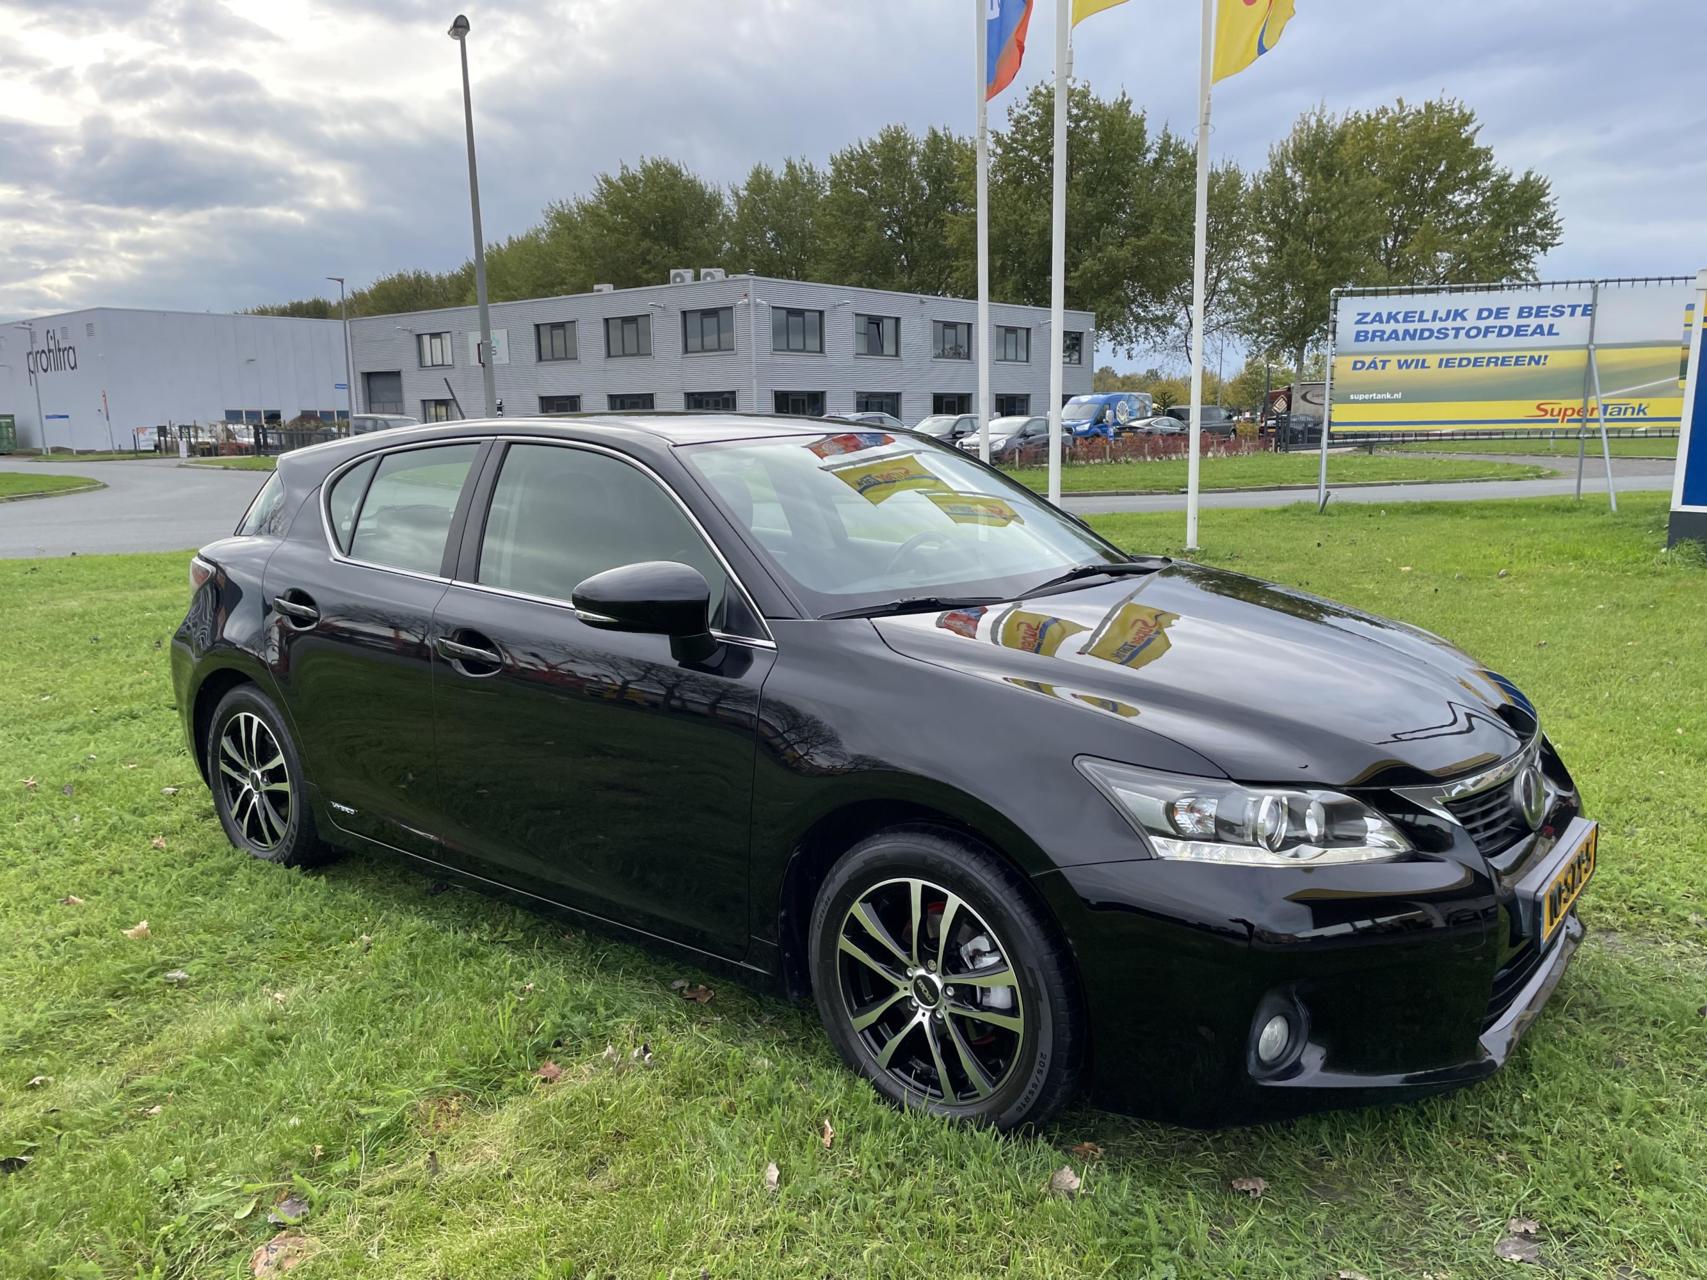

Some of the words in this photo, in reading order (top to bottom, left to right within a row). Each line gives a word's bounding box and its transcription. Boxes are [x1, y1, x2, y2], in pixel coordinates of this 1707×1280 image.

[1354, 308, 1470, 325] ZAKELIJK
[1476, 306, 1511, 321] DE
[1517, 303, 1597, 319] BESTE
[1354, 323, 1561, 343] BRANDSTOFDEAL
[26, 329, 78, 387] profiltra
[1351, 357, 1391, 371] DÁT
[1397, 358, 1431, 371] WIL
[1437, 354, 1549, 369] IEDEREEN!
[1349, 391, 1402, 401] supertank.nl
